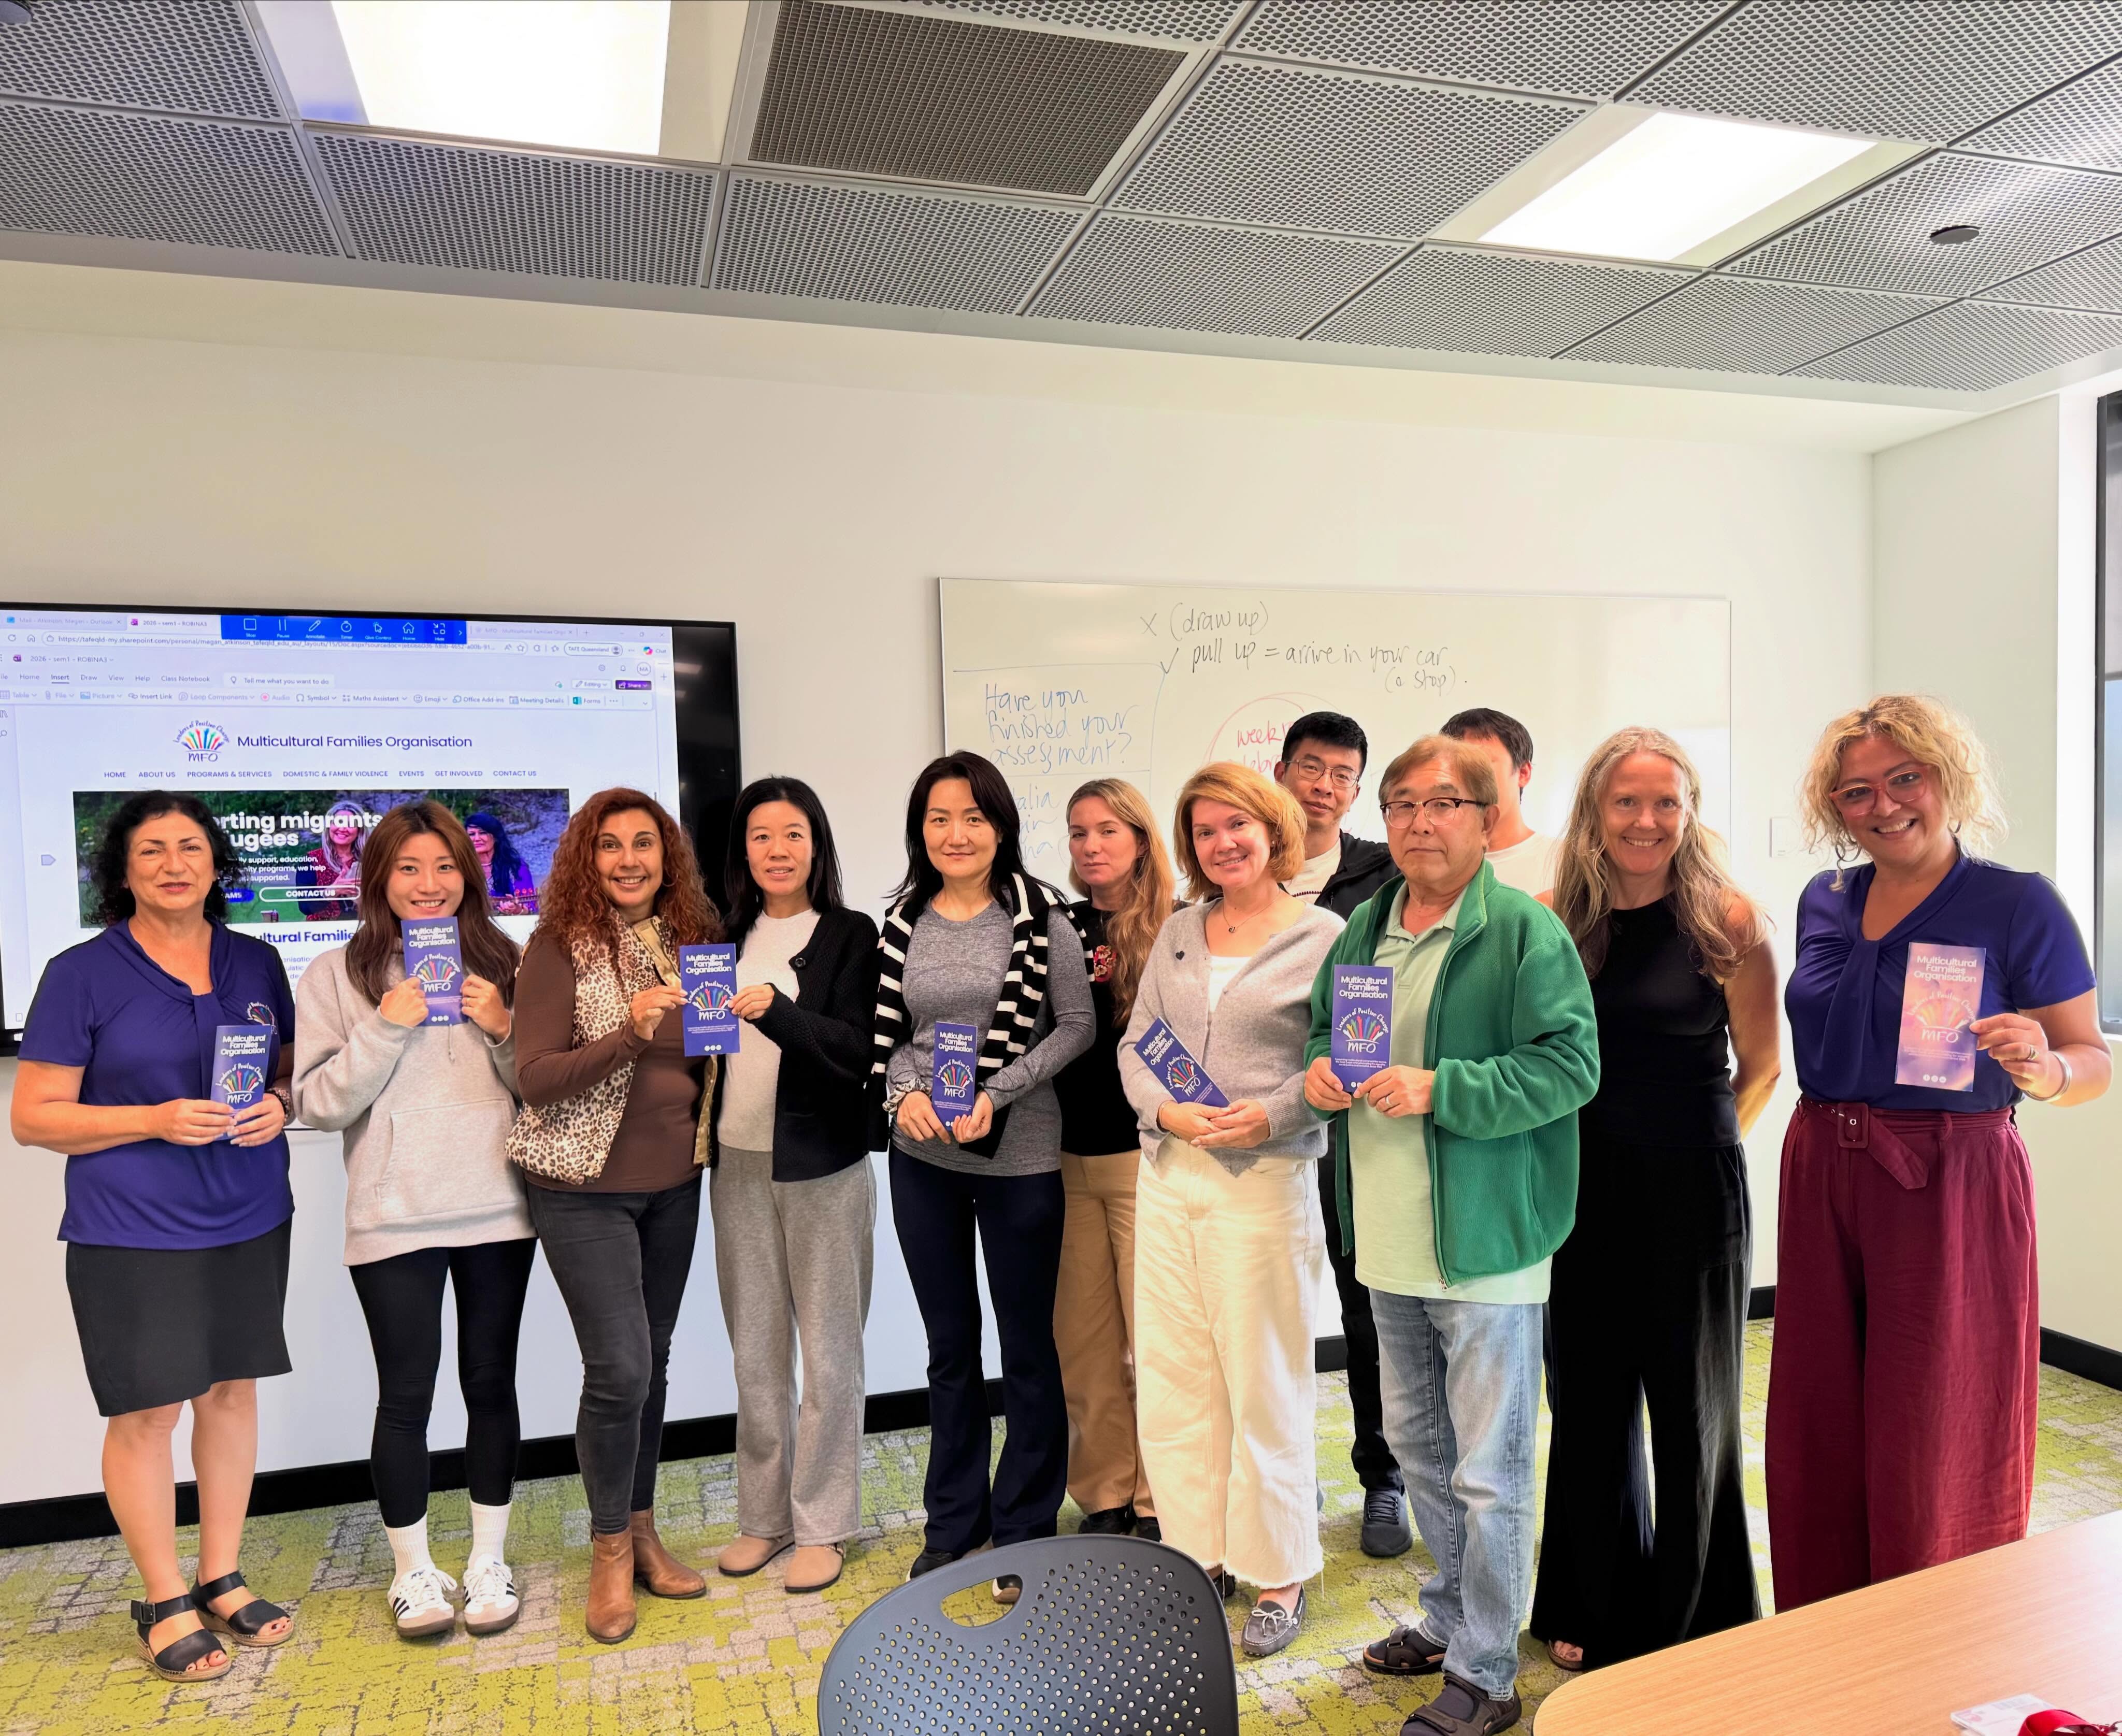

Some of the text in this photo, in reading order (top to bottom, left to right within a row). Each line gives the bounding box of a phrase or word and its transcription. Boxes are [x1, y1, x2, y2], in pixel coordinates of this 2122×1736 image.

[1193, 638, 1222, 673] pull
[1344, 644, 1361, 664] in
[1370, 645, 1410, 673] your
[1416, 648, 1448, 666] car
[237, 735, 472, 750] Multicultural Families Organisation
[189, 753, 218, 762] MFO
[281, 811, 383, 833] migrants
[229, 833, 299, 852] ugees
[305, 930, 354, 942] Familie
[409, 926, 453, 936] Multicultural
[409, 938, 455, 948] Organisation
[686, 953, 730, 962] Multicultural
[1917, 955, 1977, 968] Multicultural
[694, 960, 723, 968] Families
[1926, 964, 1966, 974] Families
[686, 965, 732, 975] Organisation
[1341, 976, 1387, 985] Multicultural
[1914, 971, 1976, 982] Organisation
[424, 982, 451, 993] MFO
[1349, 984, 1379, 992] Families
[1339, 989, 1388, 999] Organisation
[699, 1011, 725, 1021] MFO
[222, 1035, 266, 1043] Multicultural
[940, 1032, 972, 1041] Multicultural
[1922, 1029, 1958, 1043] MFO
[230, 1041, 258, 1050] Families
[945, 1038, 967, 1047] Families
[1143, 1028, 1166, 1056] Multicultural
[221, 1048, 265, 1057] Organisation
[938, 1044, 973, 1053] Organisation
[1150, 1038, 1167, 1057] Families
[1151, 1037, 1174, 1066] Organisation
[1347, 1042, 1376, 1053] MFO
[944, 1087, 965, 1098] MFO
[1184, 1078, 1200, 1097] MFO
[227, 1094, 252, 1104] MFO
